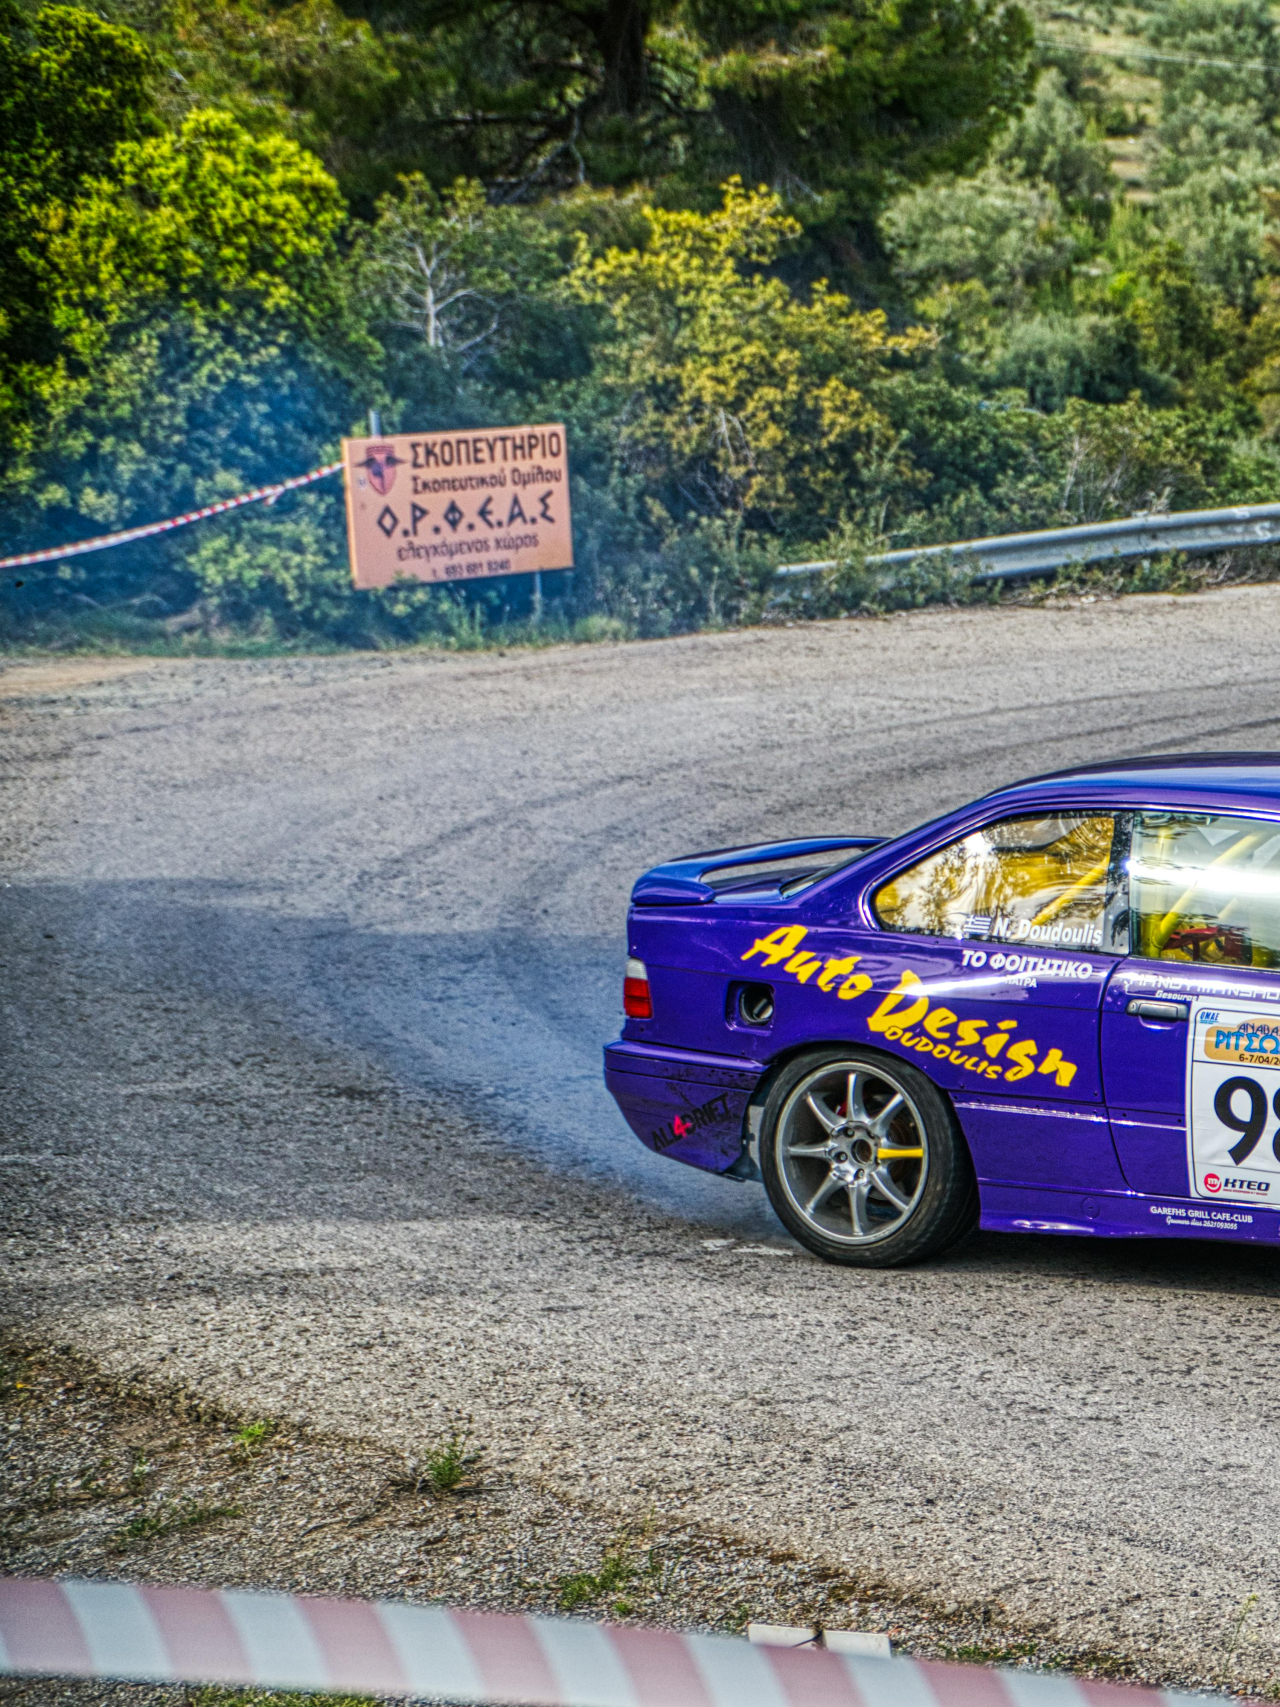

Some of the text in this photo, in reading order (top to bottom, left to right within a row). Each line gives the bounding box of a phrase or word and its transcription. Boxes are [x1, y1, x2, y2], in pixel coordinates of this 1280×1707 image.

[410, 432, 562, 469] ΣΚΟΠΕΥΤΗΡΙΟ
[412, 469, 507, 494] Σκοπευτικού
[993, 917, 1103, 945] N. Doudoulis
[962, 950, 1093, 979] ΤΟ ΦΟΙΤΗΤΙΚΟ
[741, 924, 1078, 1087] Auto Design
[1155, 990, 1199, 1002] Gesouras
[1150, 1206, 1253, 1223] GAREFHS GRILL CAFE-CLUB
